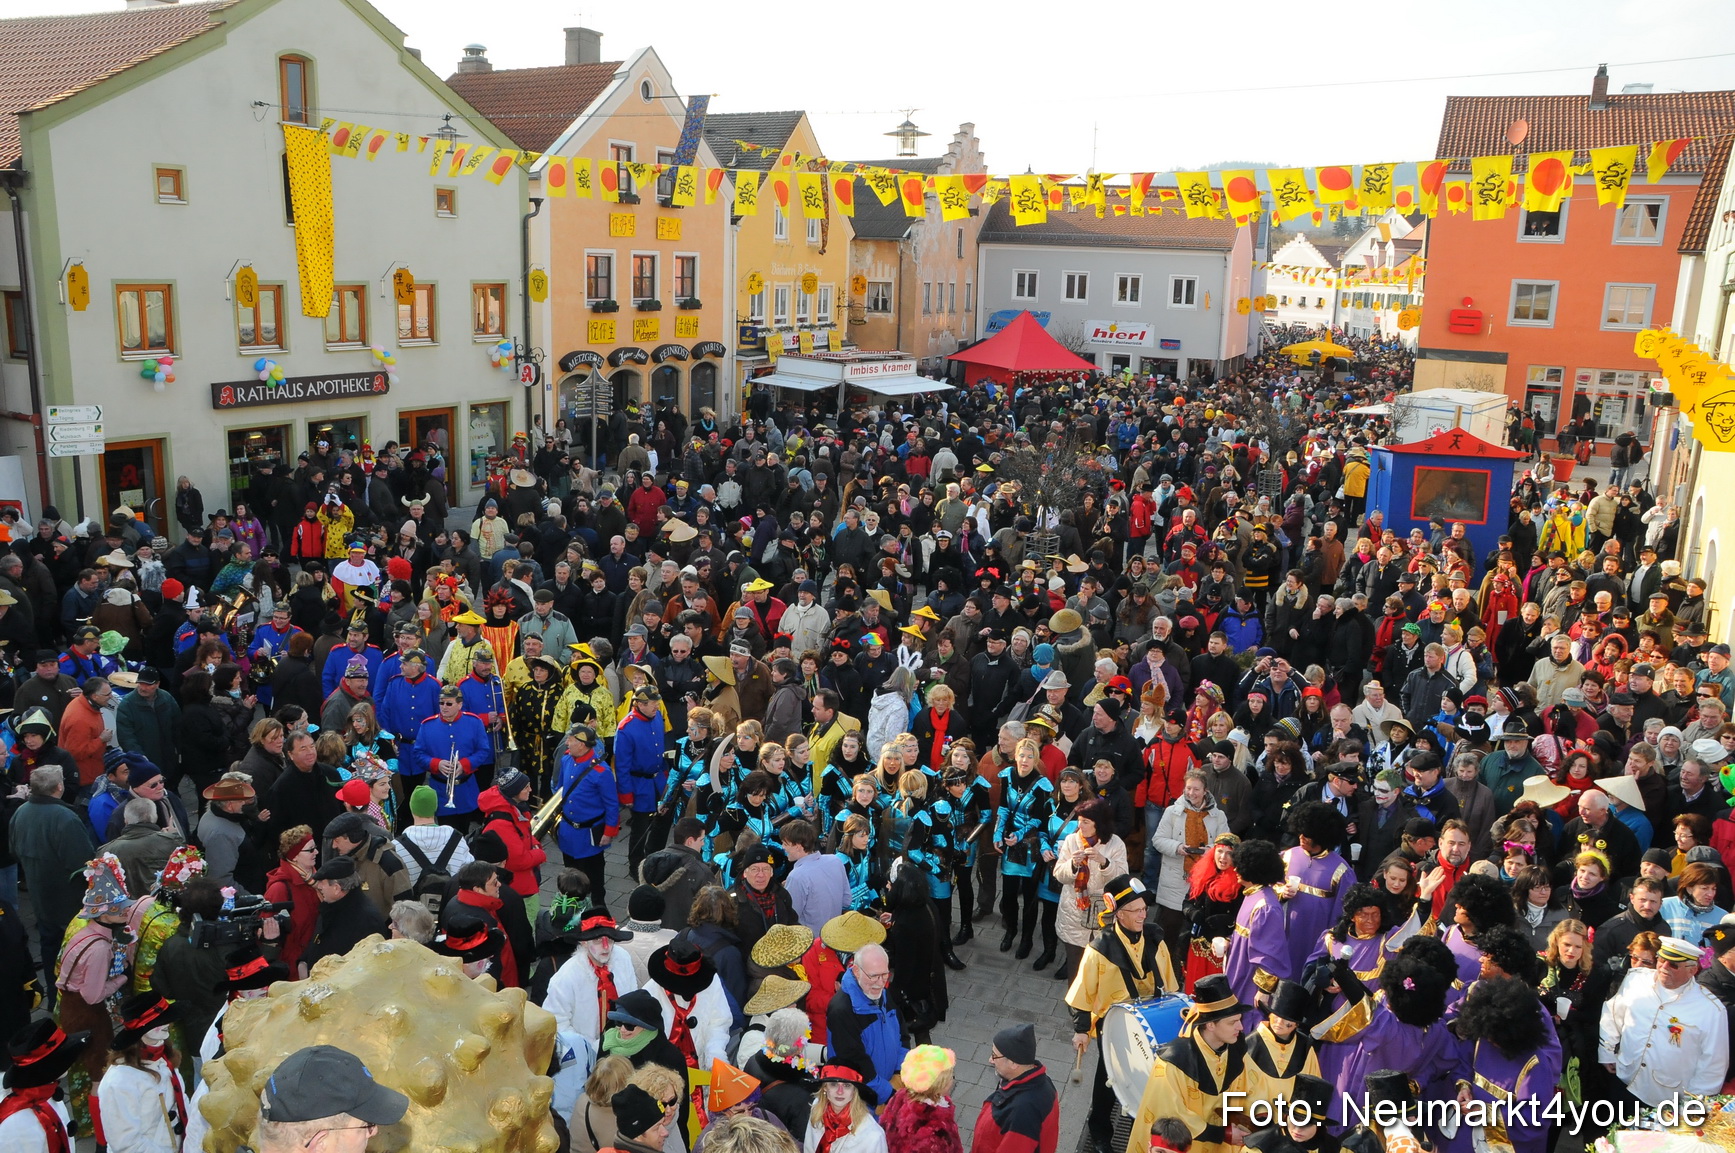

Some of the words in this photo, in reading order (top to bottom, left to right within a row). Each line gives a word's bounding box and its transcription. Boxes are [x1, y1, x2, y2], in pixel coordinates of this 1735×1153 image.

[1093, 325, 1147, 341] hierl
[659, 346, 690, 361] FEINKOST
[702, 343, 724, 355] IMBISS
[850, 365, 879, 376] Imbiss
[237, 382, 304, 403] RATHAUS
[306, 377, 371, 396] APOTHEKE
